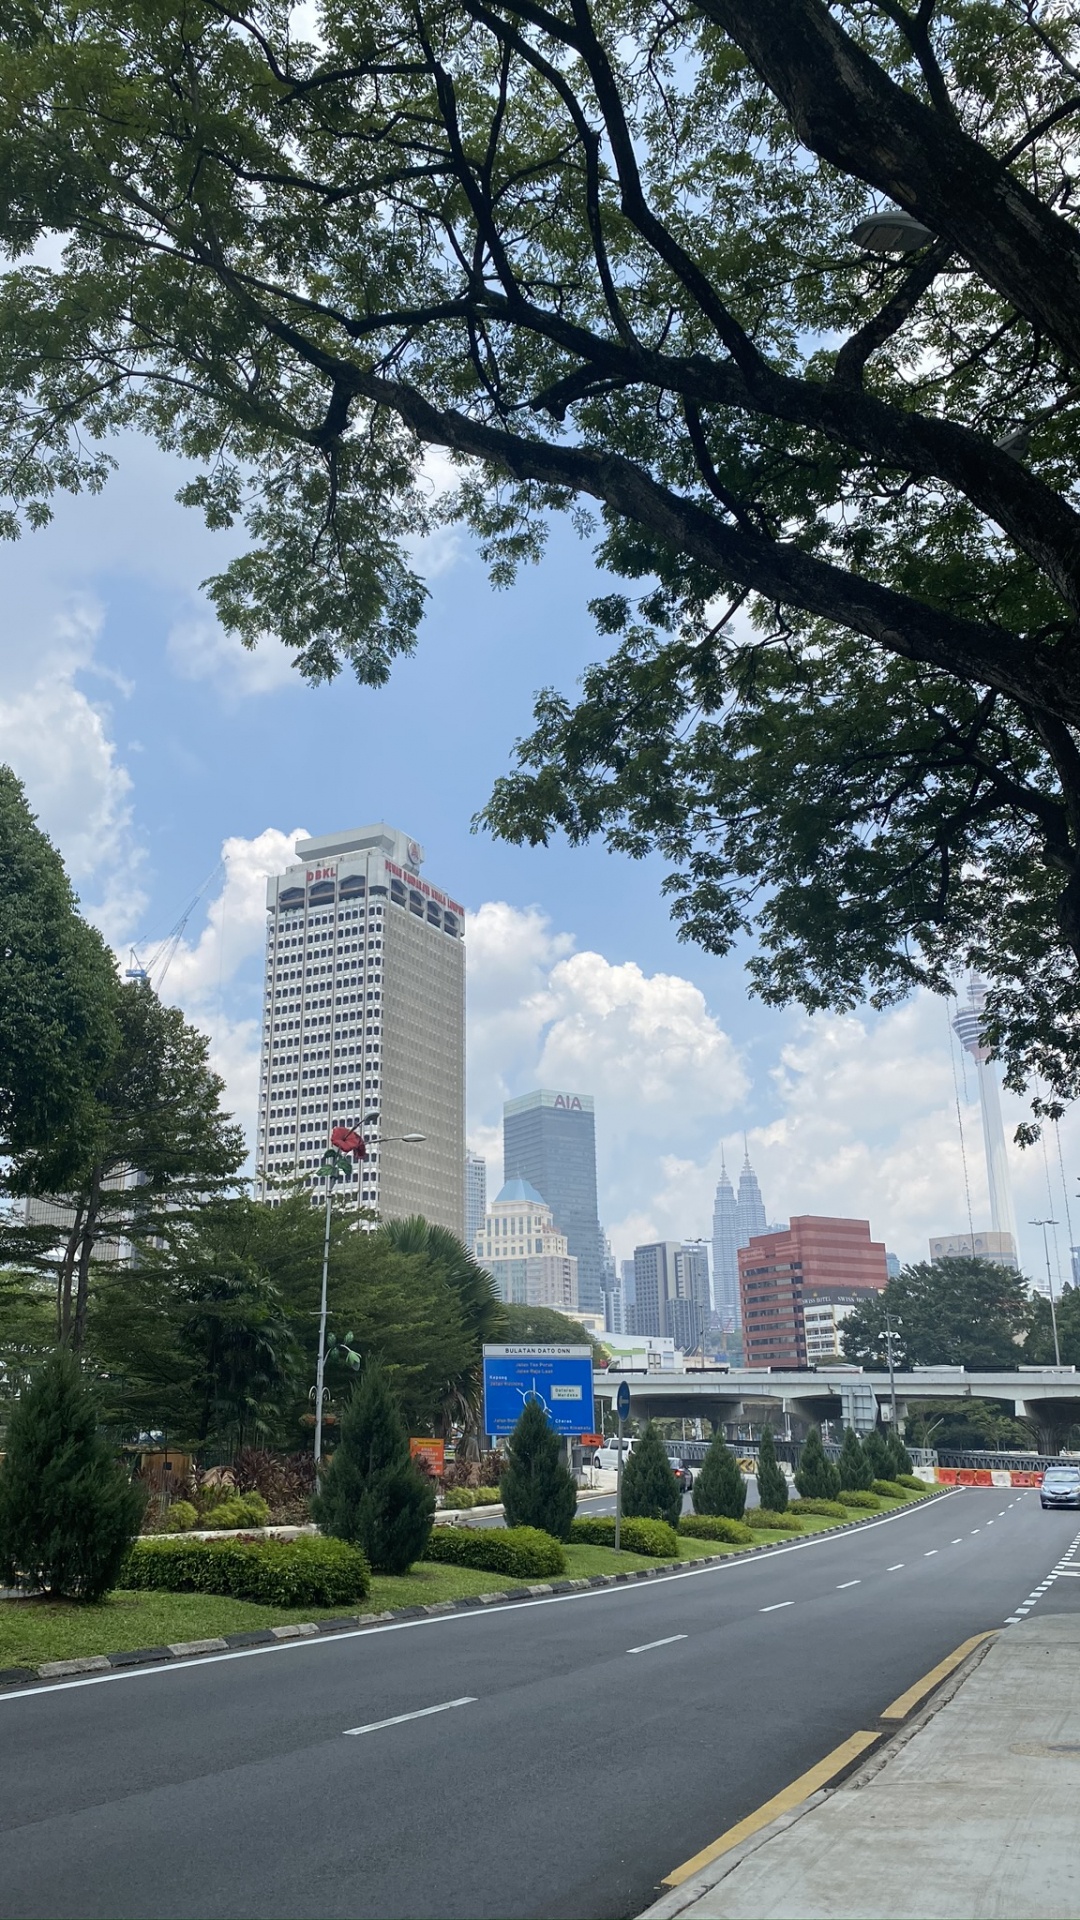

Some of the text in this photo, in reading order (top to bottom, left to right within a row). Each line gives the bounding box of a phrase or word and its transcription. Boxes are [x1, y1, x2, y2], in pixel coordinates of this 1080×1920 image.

[307, 867, 336, 881] DBKL
[385, 860, 402, 878] DEWAN
[431, 889, 446, 906] KUALA
[447, 898, 464, 916] LUMPUR
[554, 1095, 582, 1110] AIA
